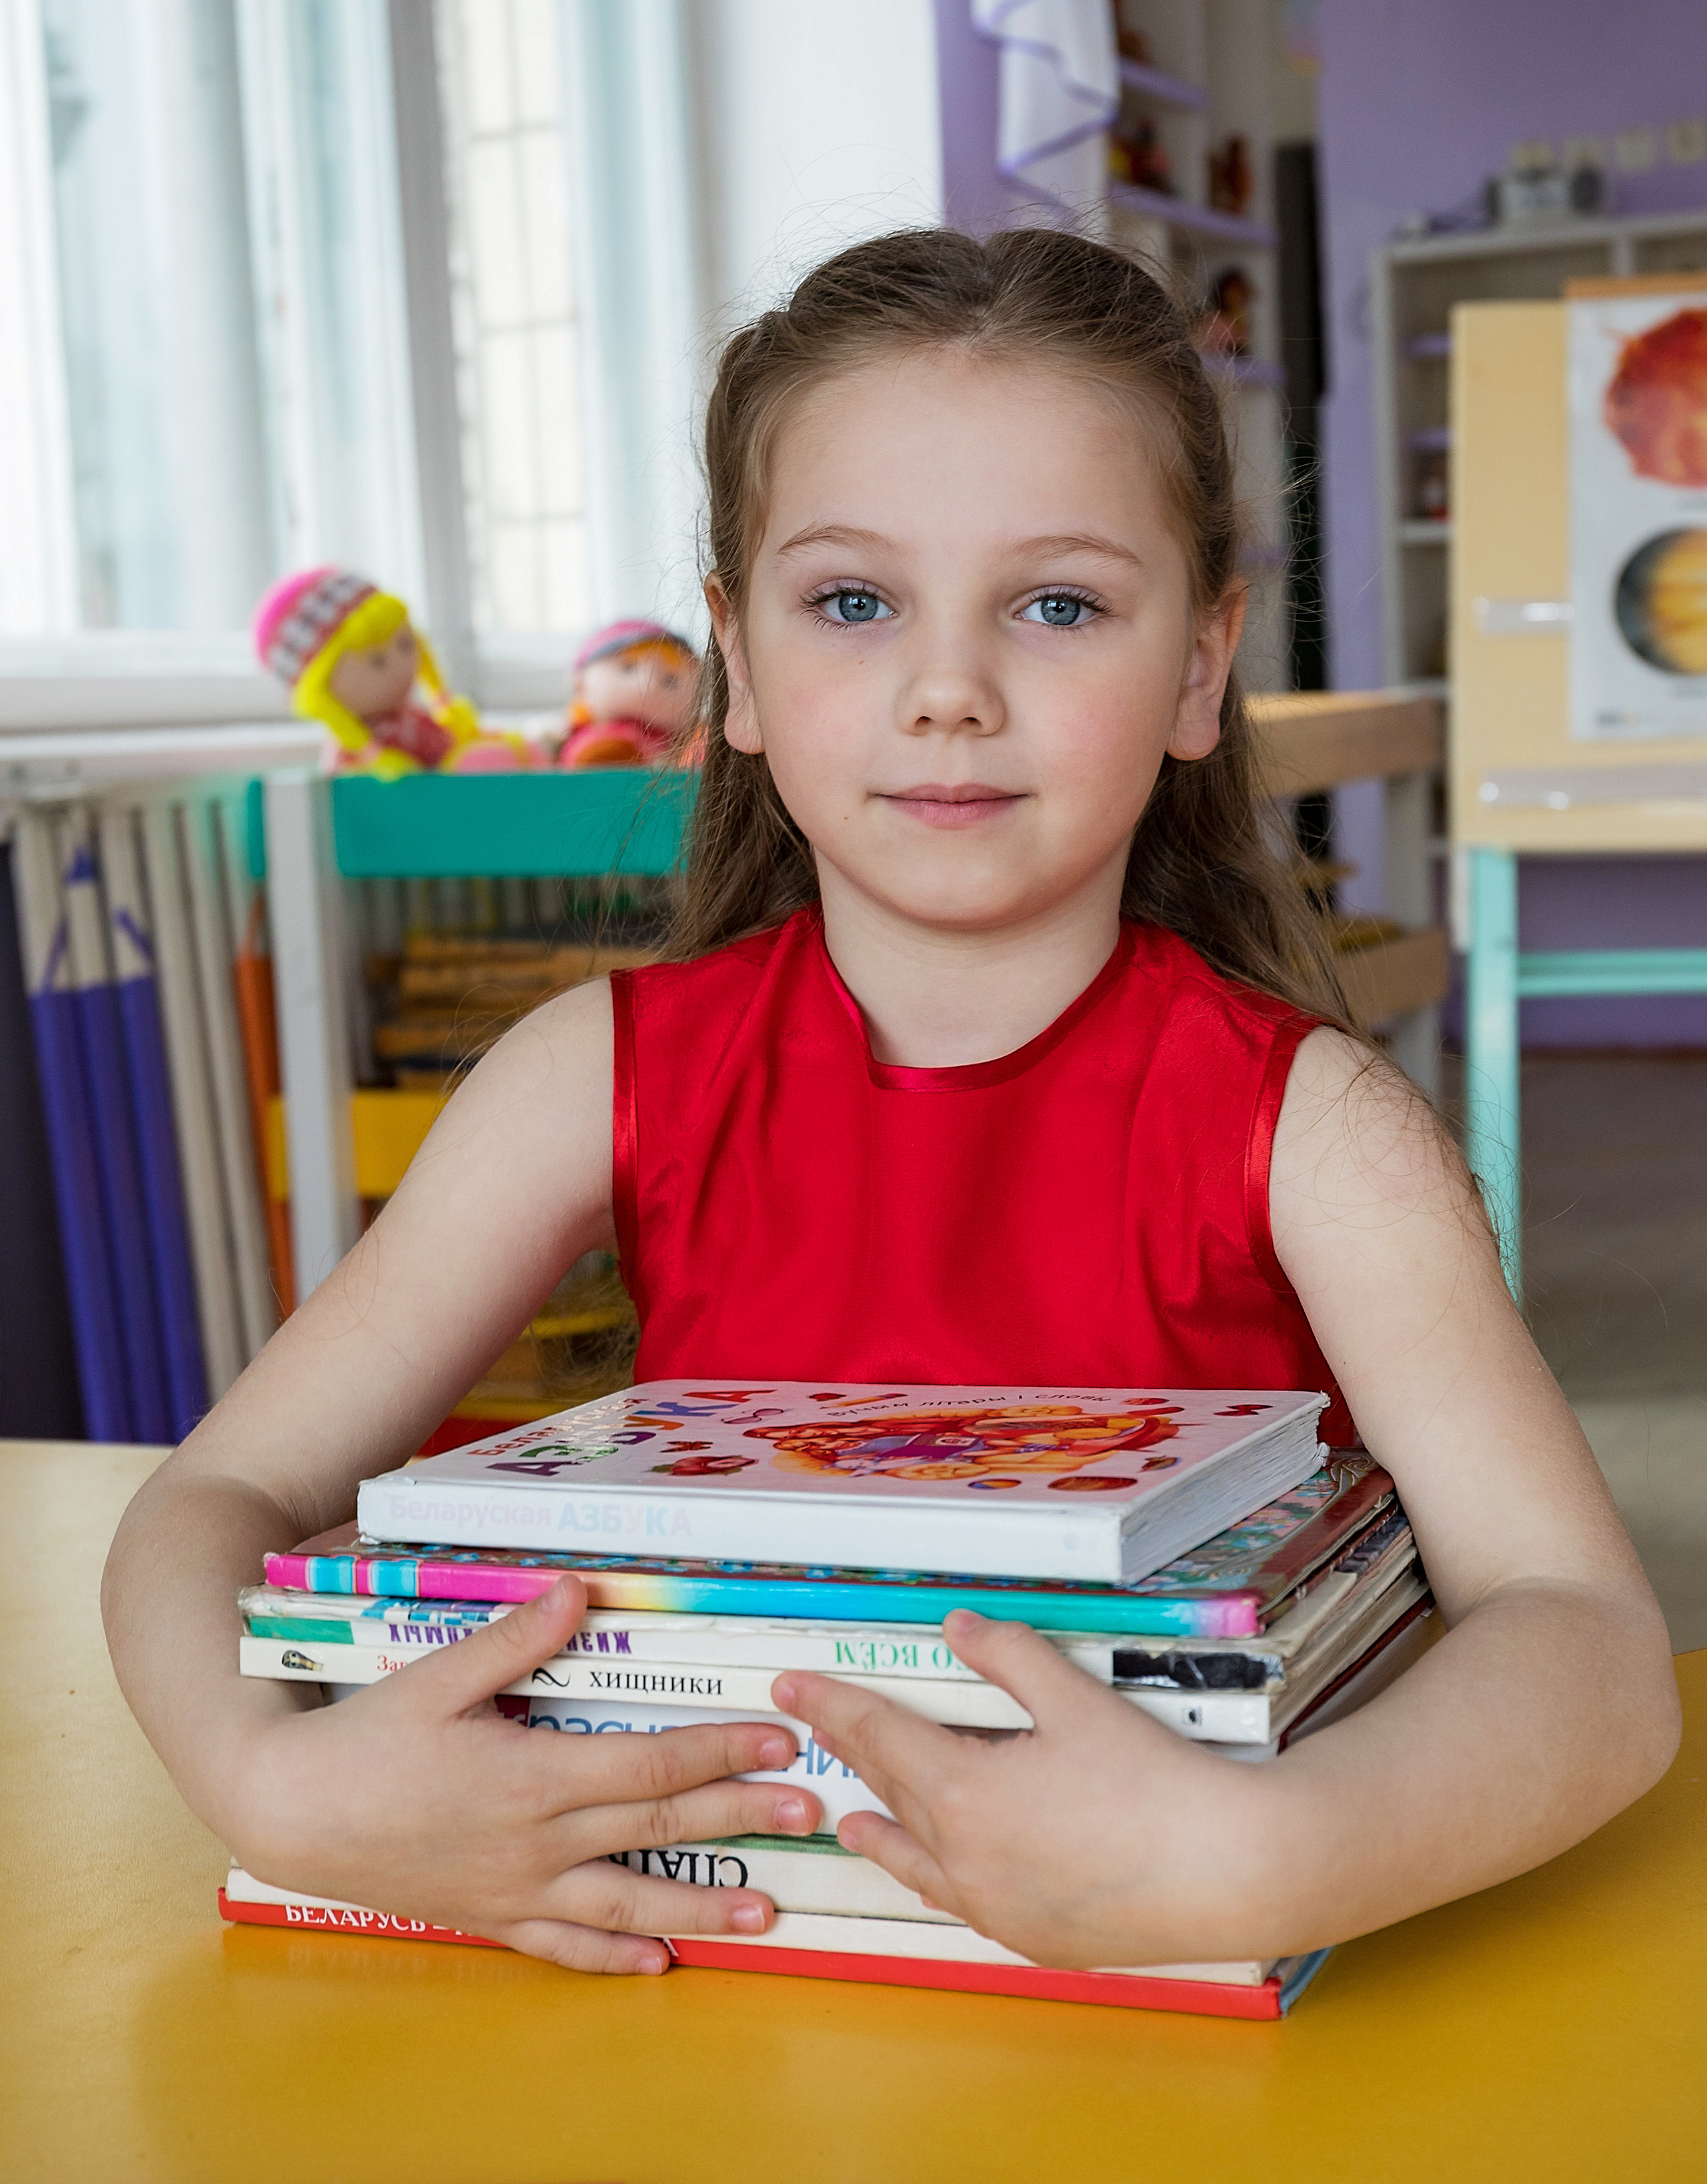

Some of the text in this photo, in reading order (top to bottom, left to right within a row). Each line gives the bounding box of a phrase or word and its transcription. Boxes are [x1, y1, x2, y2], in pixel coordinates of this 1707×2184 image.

[389, 1494, 693, 1537] Беларуская АЗБУКА
[835, 1641, 919, 1671] ВСЁМ
[589, 1671, 723, 1695] ХИЩНИКИ
[285, 1905, 427, 1932] БЕЛАРУСЬ
